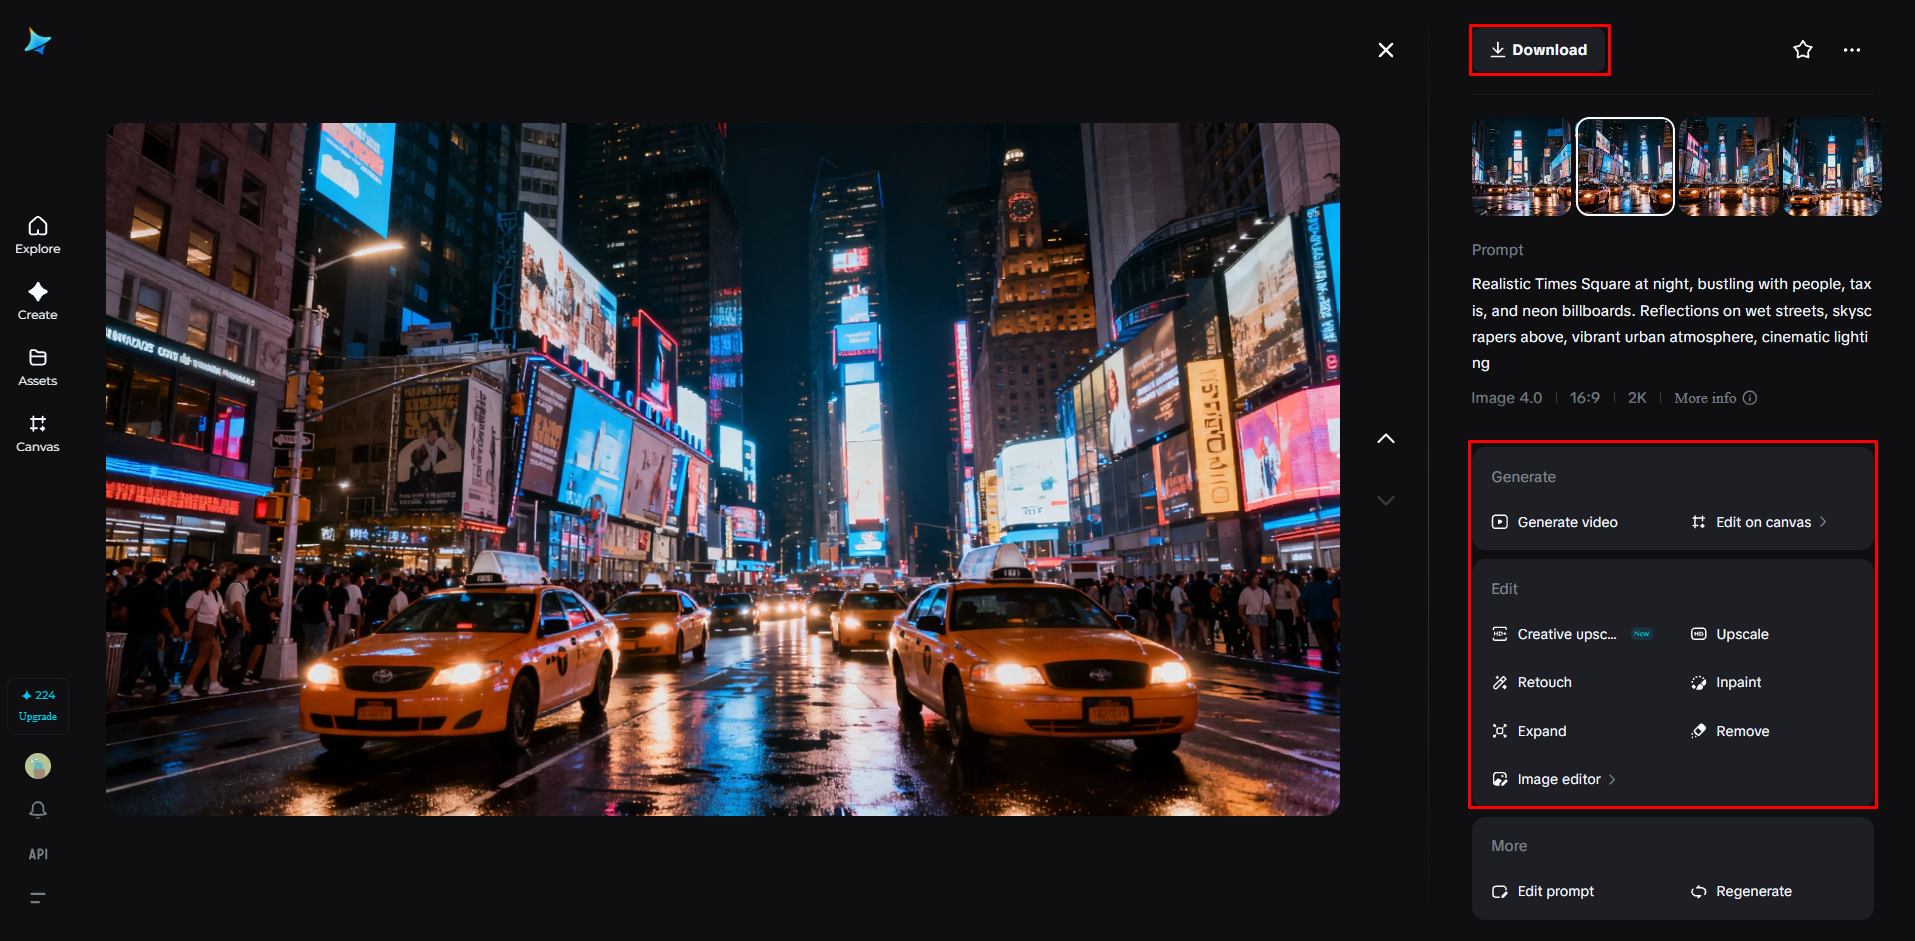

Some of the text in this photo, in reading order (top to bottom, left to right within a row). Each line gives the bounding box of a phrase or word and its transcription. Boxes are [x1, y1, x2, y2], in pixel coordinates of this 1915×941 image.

[1513, 44, 1587, 56] Download
[16, 244, 61, 256] Explore
[1472, 244, 1524, 258] Prompt
[1472, 278, 1872, 293] Realistic Times Square at night, bustling with people, tax
[18, 310, 58, 319] Create
[1472, 304, 1872, 319] is, and neon billboards. Reflections on wet streets, skysc
[1472, 331, 1868, 346] rapers above, vibrant urban atmosphere, cinematic lighti
[1472, 359, 1490, 372] ng
[18, 376, 58, 385] Assets
[1472, 392, 1542, 406] Image 4.0
[1570, 392, 1600, 403] 16:9
[1628, 392, 1647, 403] 2K
[1675, 392, 1737, 403] More info
[16, 442, 60, 451] Canvas
[1492, 471, 1556, 483] Generate
[1518, 516, 1618, 528] Generate video
[1717, 516, 1811, 528] Edit on canvas
[1492, 583, 1518, 595] Edit
[1518, 628, 1572, 640] Creative
[1717, 628, 1769, 642] Upscale
[1518, 676, 1572, 688] Retouch
[1717, 676, 1761, 690] Inpaint
[35, 690, 56, 700] 224
[19, 711, 57, 724] Upgrade
[1518, 725, 1566, 739] Expand
[1717, 726, 1770, 737] Remove
[1518, 773, 1601, 787] Image editor
[1492, 840, 1527, 852] More
[29, 848, 47, 860] API
[1518, 885, 1594, 899] Edit prompt
[1717, 886, 1792, 899] Regenerate
